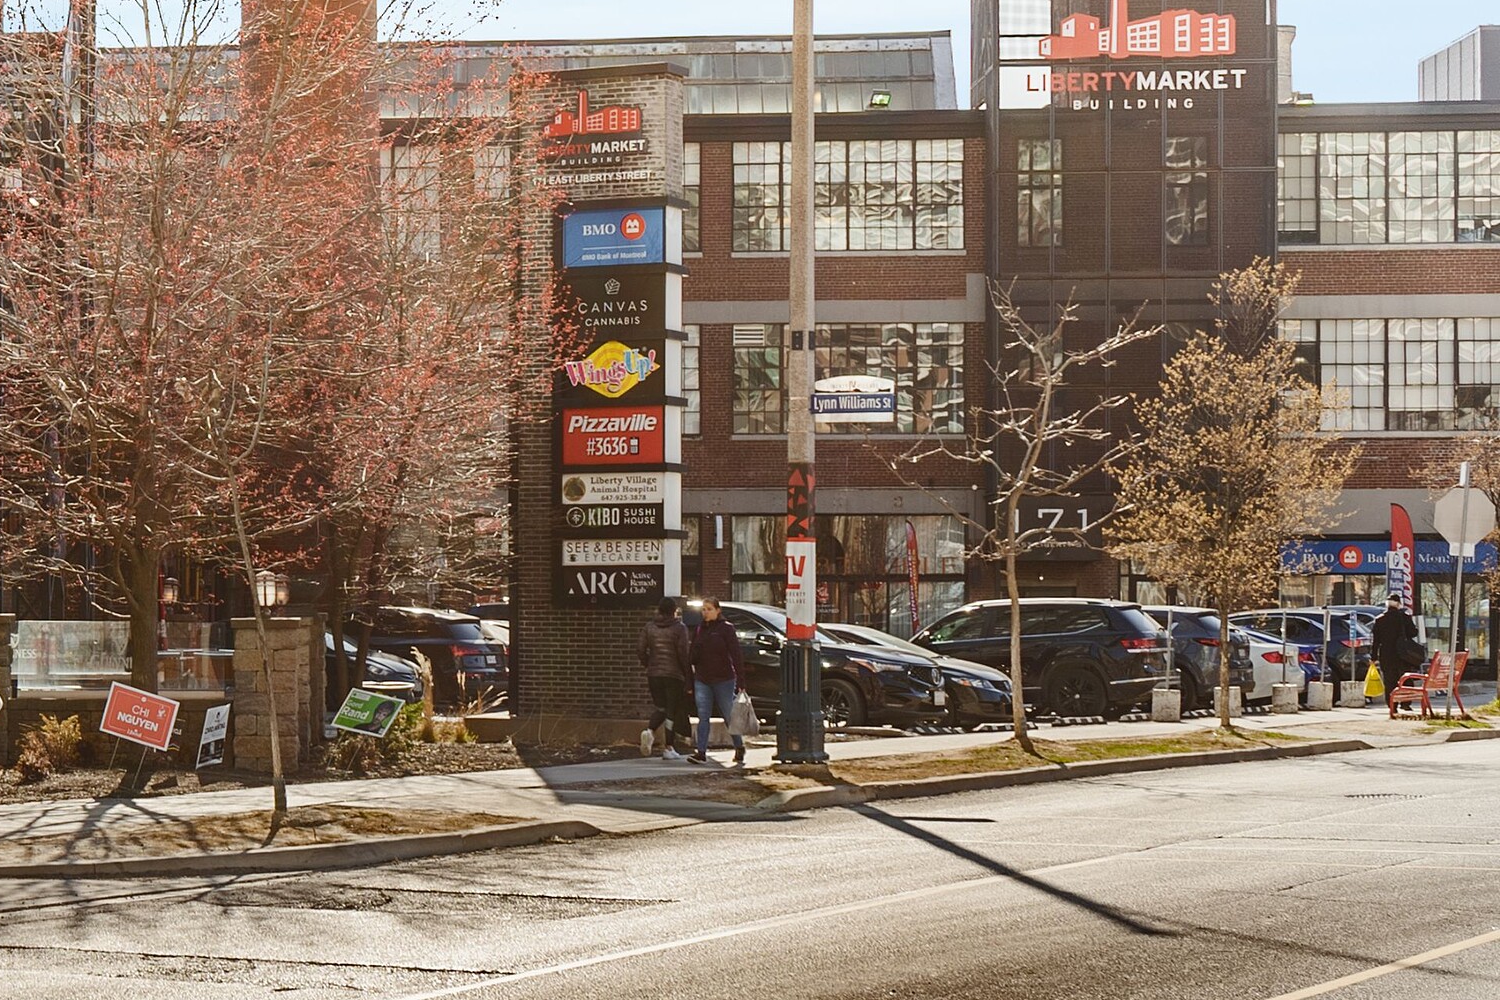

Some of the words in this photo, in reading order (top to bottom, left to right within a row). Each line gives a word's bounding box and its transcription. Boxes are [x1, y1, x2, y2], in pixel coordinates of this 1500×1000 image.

[1073, 98, 1195, 111] BUILDING
[561, 156, 621, 166] BUILDING
[548, 175, 574, 186] EAST
[575, 171, 615, 184] LIBERTY
[615, 169, 652, 181] STREET
[582, 223, 616, 237] BMO
[597, 252, 611, 260] Bank
[612, 251, 619, 259] of
[620, 250, 647, 259] Montreal
[577, 300, 648, 314] CANVAS
[585, 316, 641, 327] CANNABIS
[813, 396, 838, 412] Lynn
[838, 395, 881, 409] Williams
[882, 397, 891, 408] St
[568, 413, 658, 433] Pizzaville
[586, 436, 628, 455] #3636
[590, 477, 623, 487] Liberty
[626, 475, 657, 485] Village
[590, 486, 620, 494] Animal
[622, 484, 657, 494] Hospital
[588, 507, 620, 526] KIBO
[623, 508, 656, 516] SUSHI
[623, 516, 656, 525] HOUSE
[566, 542, 589, 553] SEE
[594, 542, 601, 552] &
[606, 542, 622, 553] BE
[626, 541, 660, 553] SEEN
[584, 553, 640, 562] EYECARE
[1303, 553, 1335, 563] BMO
[568, 572, 627, 594] ARC
[630, 571, 651, 579] Active
[629, 586, 647, 594] Club
[131, 704, 150, 718] CHI
[341, 706, 370, 720] Rand
[116, 711, 160, 732] NGUYEN
